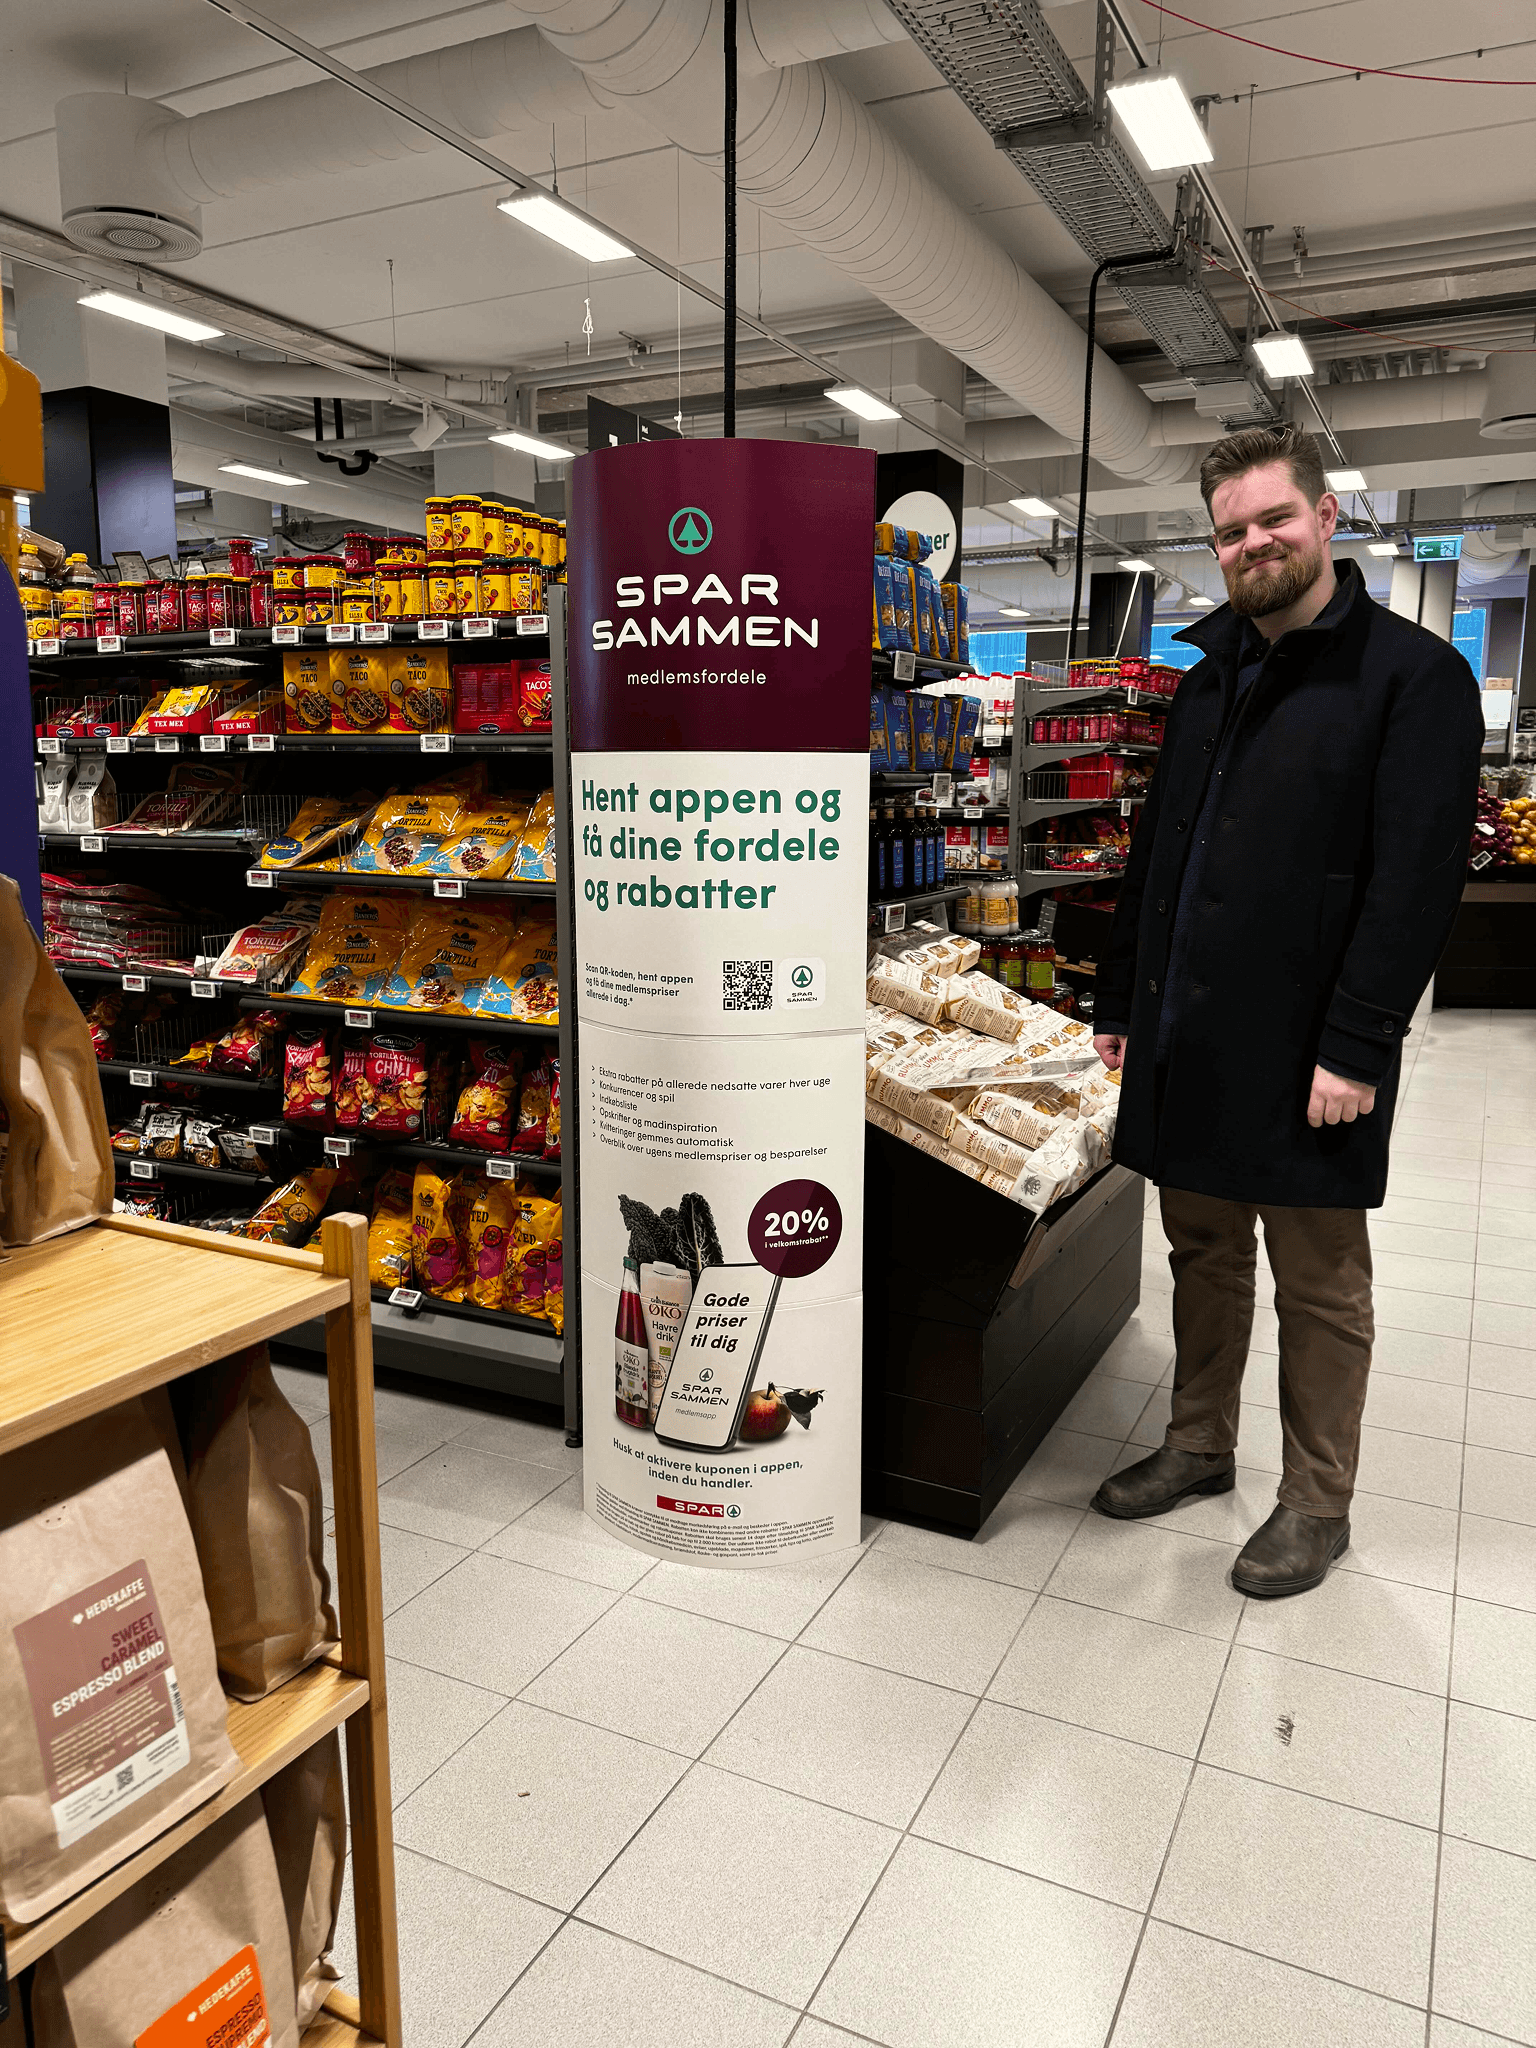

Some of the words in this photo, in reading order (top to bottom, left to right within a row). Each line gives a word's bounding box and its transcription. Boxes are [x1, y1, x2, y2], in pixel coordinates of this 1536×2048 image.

[616, 573, 780, 608] SPAR
[591, 615, 819, 651] SAMMEN
[300, 674, 318, 683] TACO
[350, 672, 368, 681] TACO
[408, 671, 427, 680] TACO
[627, 669, 767, 686] medlemsfordele
[525, 680, 547, 691] TACO
[154, 720, 168, 728] TEX
[582, 779, 639, 812] Hent
[649, 789, 781, 822] appen
[795, 789, 841, 822] og
[470, 827, 512, 837] TORTILLA
[583, 823, 603, 857] få
[610, 827, 682, 861] dine
[694, 828, 840, 862] fordele
[584, 879, 609, 912] og
[617, 875, 776, 909] rabatter
[244, 936, 288, 946] TORTILLA
[333, 953, 376, 964] TORTILLA
[585, 962, 599, 974] Scan
[599, 965, 636, 981] QR-koden,
[637, 971, 658, 983] hent
[660, 974, 694, 986] appen
[585, 977, 593, 987] og
[593, 977, 600, 987] få
[600, 979, 614, 990] dine
[615, 982, 680, 997] medlemspriser
[586, 989, 609, 1003] allerede
[786, 996, 818, 1004] SAMMEN
[599, 1066, 617, 1079] Ekstra
[618, 1073, 649, 1086] rabatter
[651, 1078, 664, 1089] på
[666, 1080, 708, 1091] allerede
[710, 1081, 757, 1091] nedsatte
[759, 1081, 787, 1090] varer
[789, 1079, 811, 1088] hver
[813, 1077, 831, 1088] uge
[599, 1080, 644, 1099] Konkurrencer
[645, 1092, 657, 1103] og
[658, 1093, 675, 1104] spil
[599, 1093, 638, 1111] Indkøbsliste
[599, 1107, 631, 1124] Opskrifter
[632, 1117, 643, 1128] og
[644, 1120, 718, 1134] madinspiration
[599, 1120, 636, 1139] Kvitteringer
[637, 1132, 674, 1145] gemmes
[676, 1137, 734, 1148] automatisk
[600, 1133, 626, 1150] Overblik
[626, 1144, 644, 1155] over
[645, 1148, 673, 1159] ugens
[674, 1150, 752, 1162] medlemspriser
[754, 1152, 768, 1162] og
[770, 1146, 828, 1160] besparelser
[764, 1206, 829, 1237] 20%
[703, 1292, 750, 1307] Gode
[648, 1303, 682, 1320] ØKO
[695, 1313, 748, 1329] priser
[652, 1320, 679, 1333] Havre
[656, 1330, 675, 1343] drik
[690, 1333, 709, 1348] til
[710, 1334, 739, 1353] dig
[670, 1391, 729, 1406] SAMMEN
[681, 1383, 722, 1395] SPAR
[674, 1407, 717, 1420] medlemsapp
[613, 1437, 633, 1456] Husk
[634, 1450, 645, 1461] at
[647, 1454, 692, 1472] aktivere
[695, 1463, 750, 1477] kuponen
[753, 1463, 758, 1474] i
[760, 1459, 803, 1476] appen,
[648, 1466, 679, 1483] inden
[682, 1476, 697, 1487] du
[700, 1477, 753, 1489] handler.
[674, 1501, 724, 1516] SPAR
[85, 1578, 145, 1620] HEDEKAFFE
[111, 1612, 154, 1648] SWEET
[101, 1628, 162, 1672] CARAMEL
[52, 1666, 123, 1718] ESPRESSO
[124, 1640, 166, 1676] BLEND
[198, 1964, 253, 2015] HEDEKAFFE
